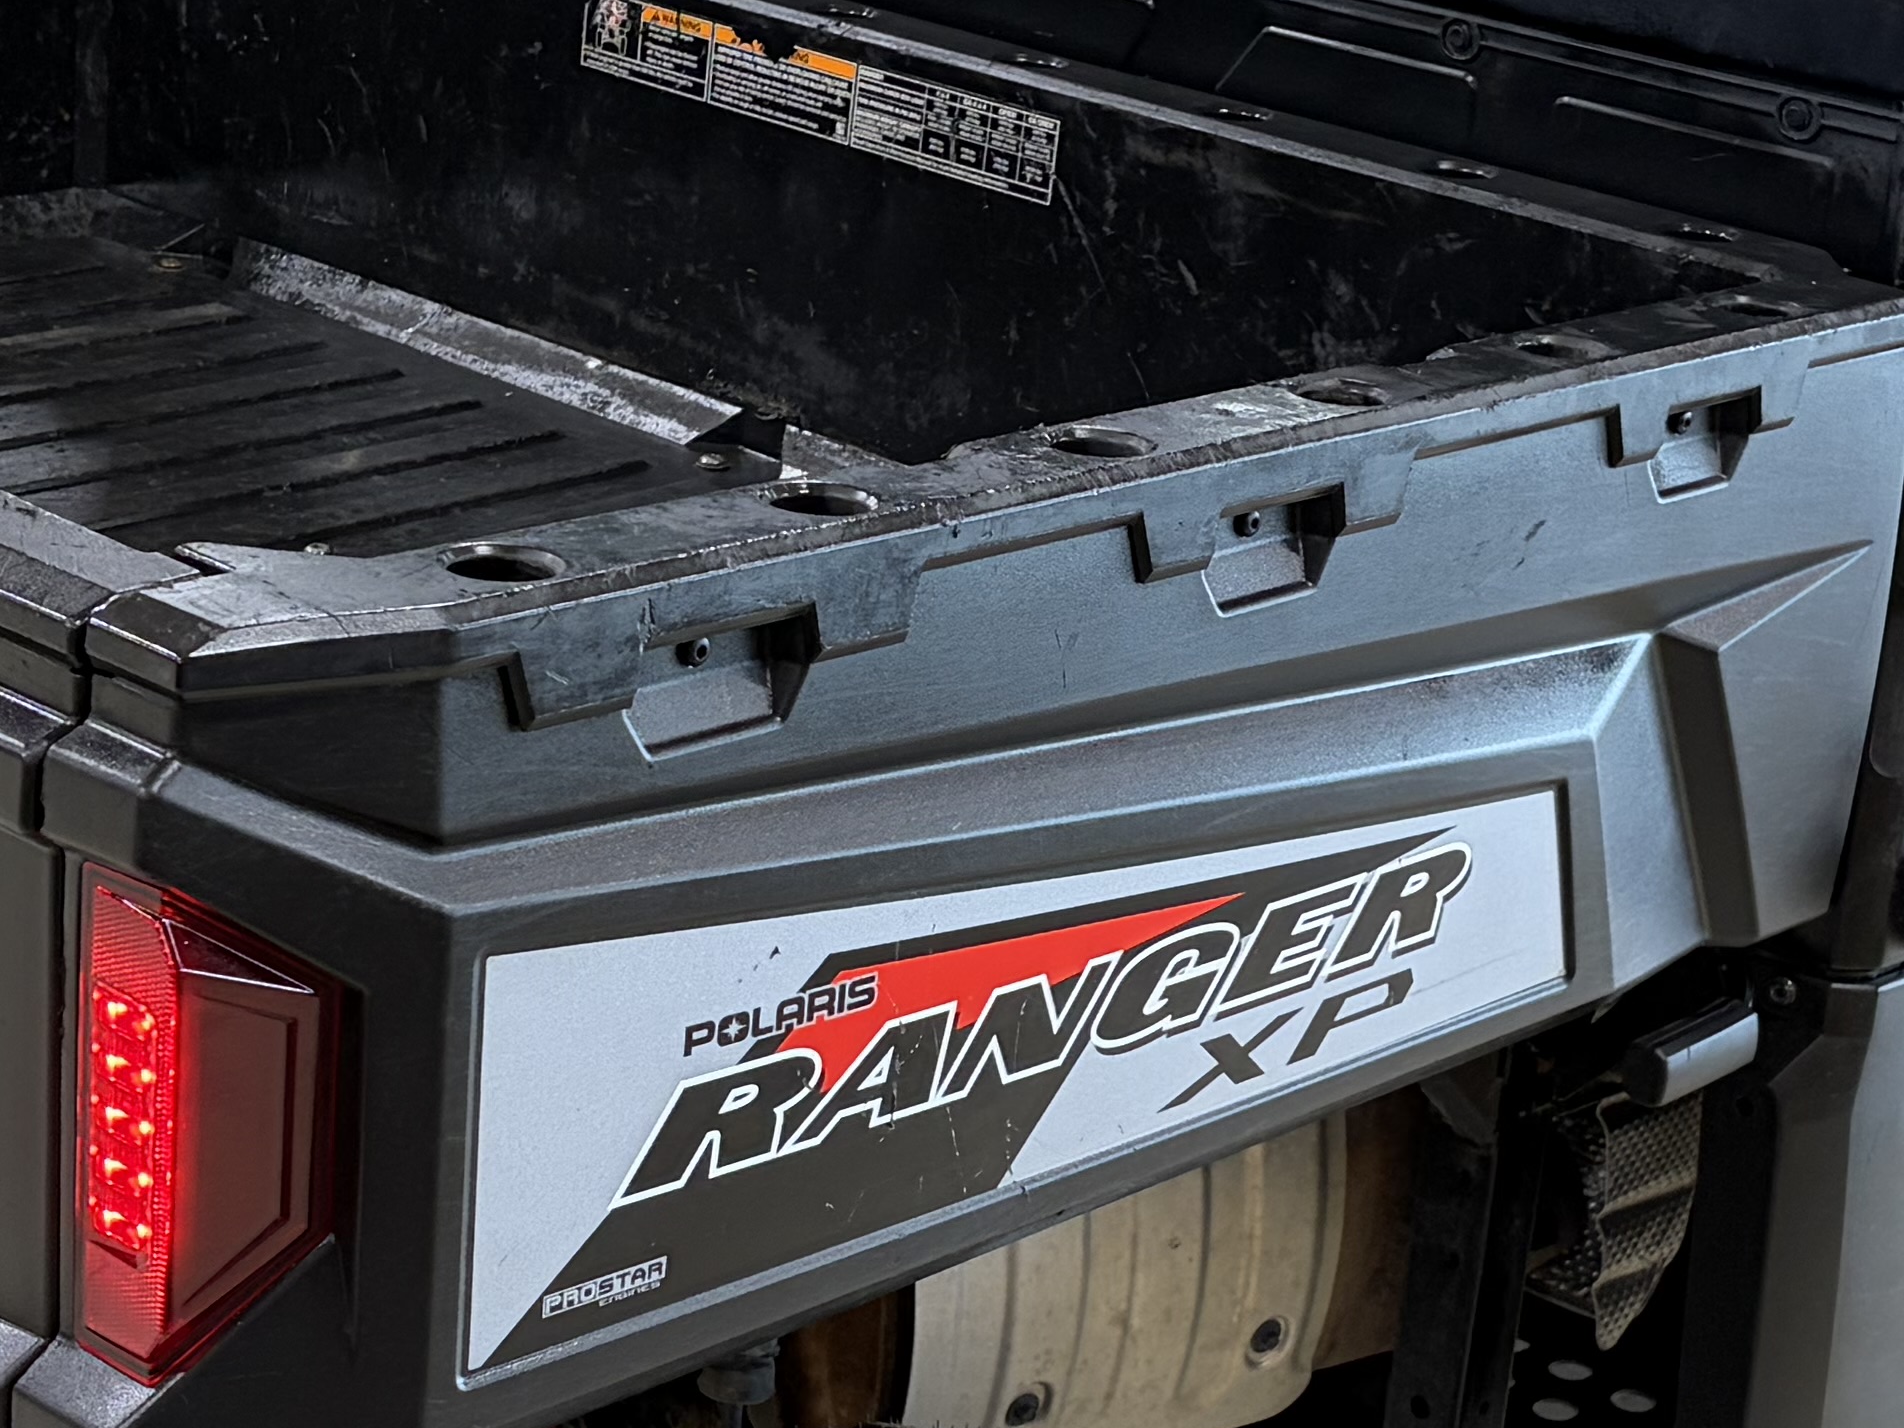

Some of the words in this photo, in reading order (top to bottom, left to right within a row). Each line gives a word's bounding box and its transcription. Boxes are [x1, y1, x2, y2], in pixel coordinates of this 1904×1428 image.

[608, 842, 1472, 1209] RANGER
[682, 974, 877, 1057] POLARIS
[1159, 969, 1415, 1112] XP
[544, 1259, 666, 1316] PROSTAR
